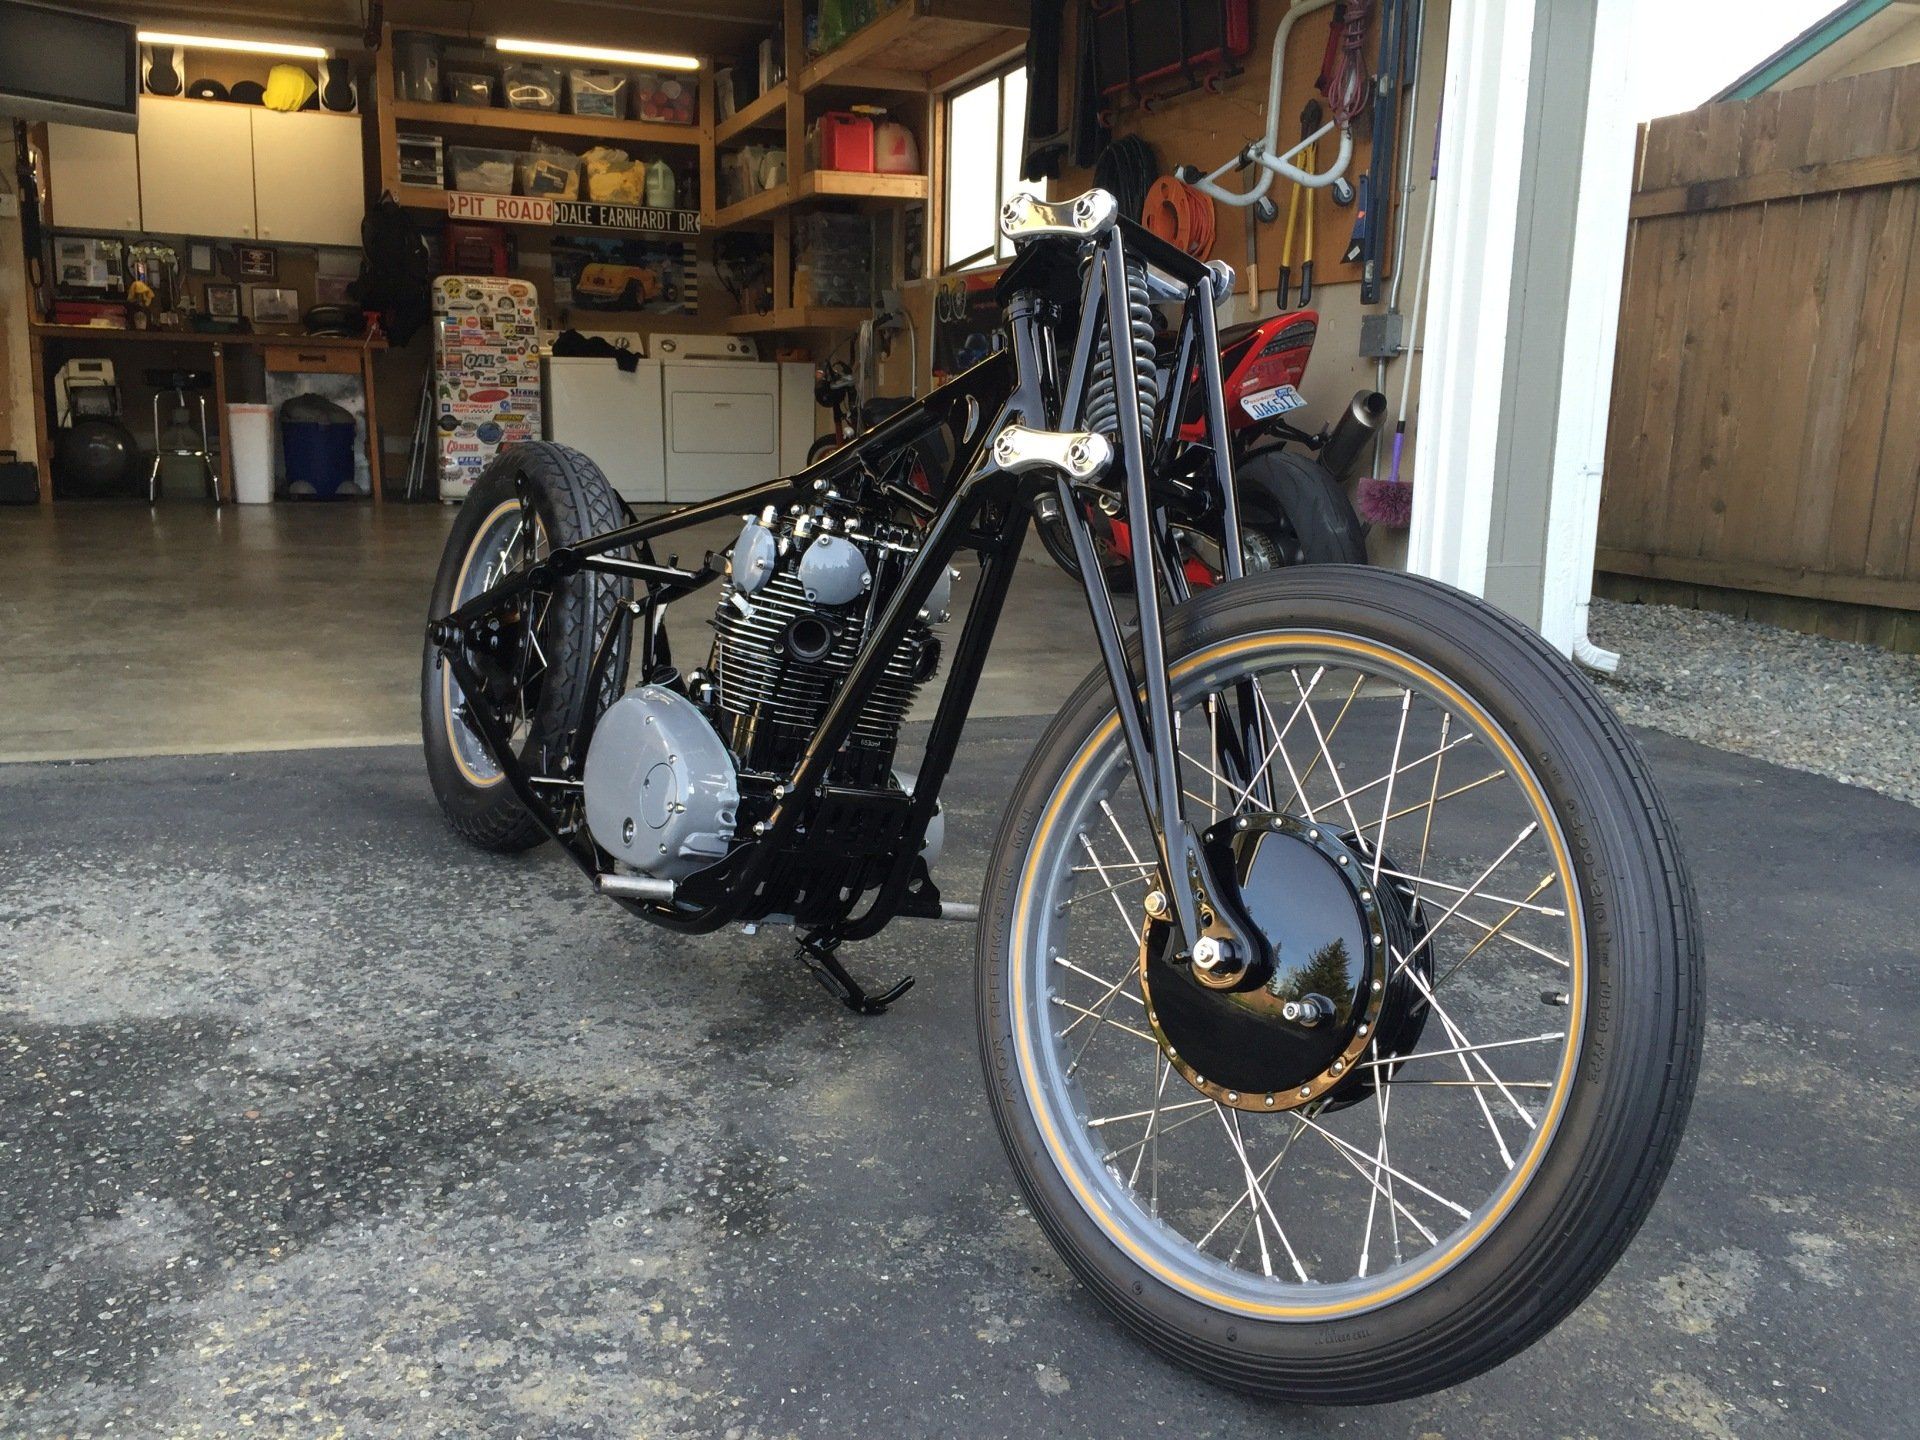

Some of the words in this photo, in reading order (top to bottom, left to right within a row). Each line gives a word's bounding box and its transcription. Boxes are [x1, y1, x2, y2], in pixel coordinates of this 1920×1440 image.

[458, 196, 485, 216] PIT
[496, 199, 544, 221] ROAD
[560, 203, 593, 225] DALE
[600, 206, 672, 231] EARNHARDT
[679, 215, 696, 232] DR
[465, 354, 495, 369] QA1
[989, 867, 1014, 1018] SPEEDMASTER
